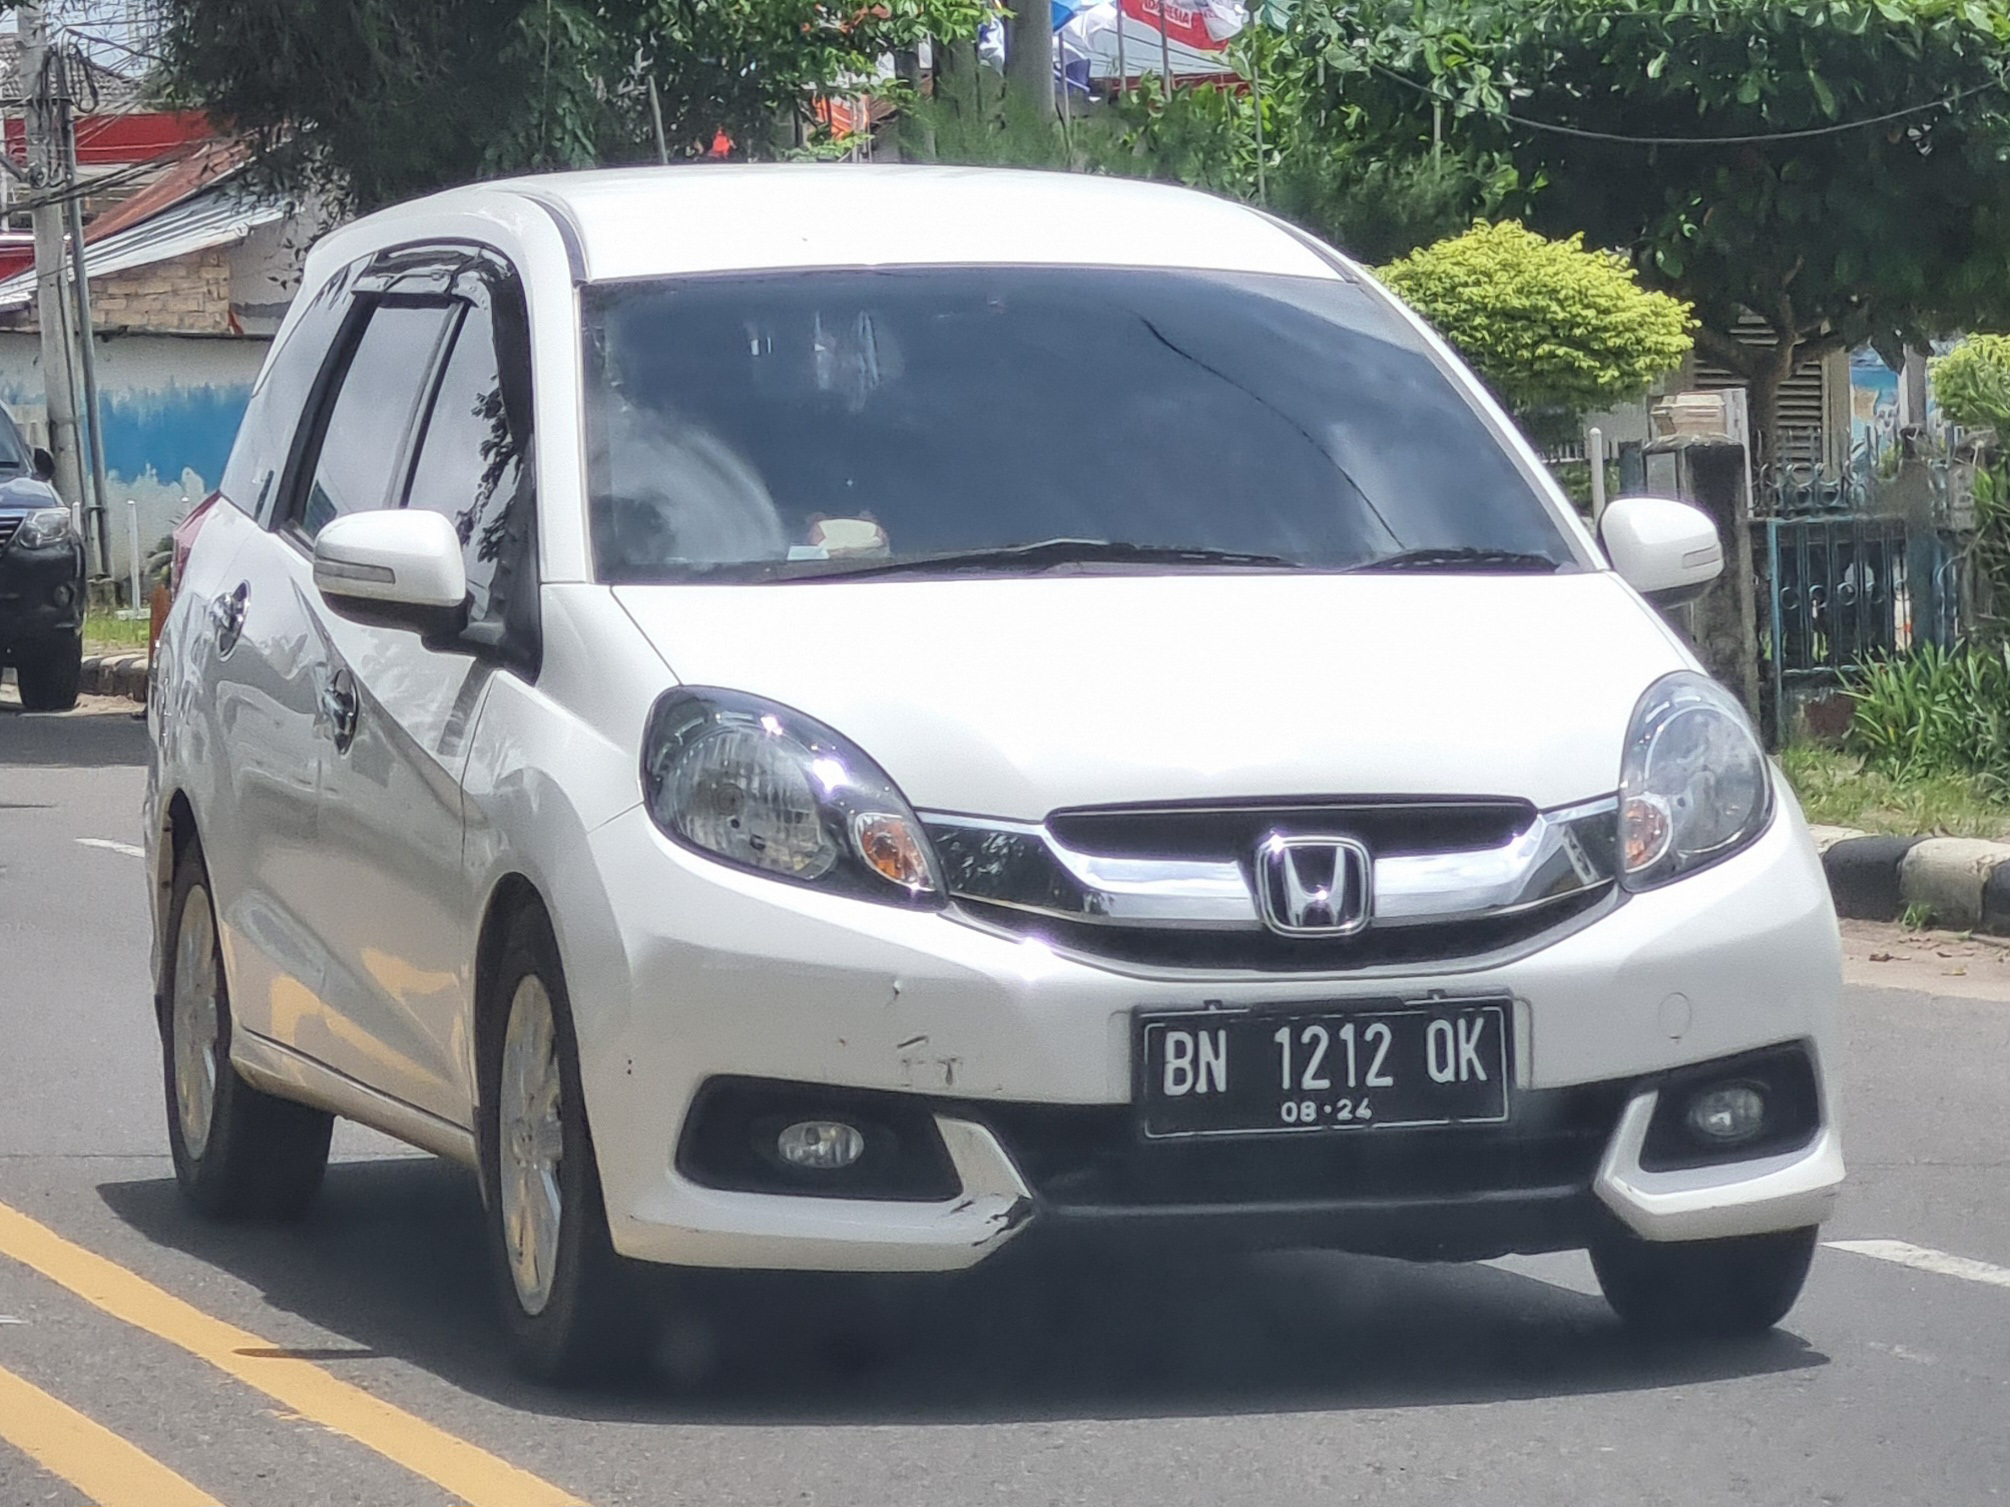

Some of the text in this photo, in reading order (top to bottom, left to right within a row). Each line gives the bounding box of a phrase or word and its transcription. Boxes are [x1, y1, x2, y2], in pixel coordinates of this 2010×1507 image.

[1164, 1017, 1488, 1096] BN 1212 QK
